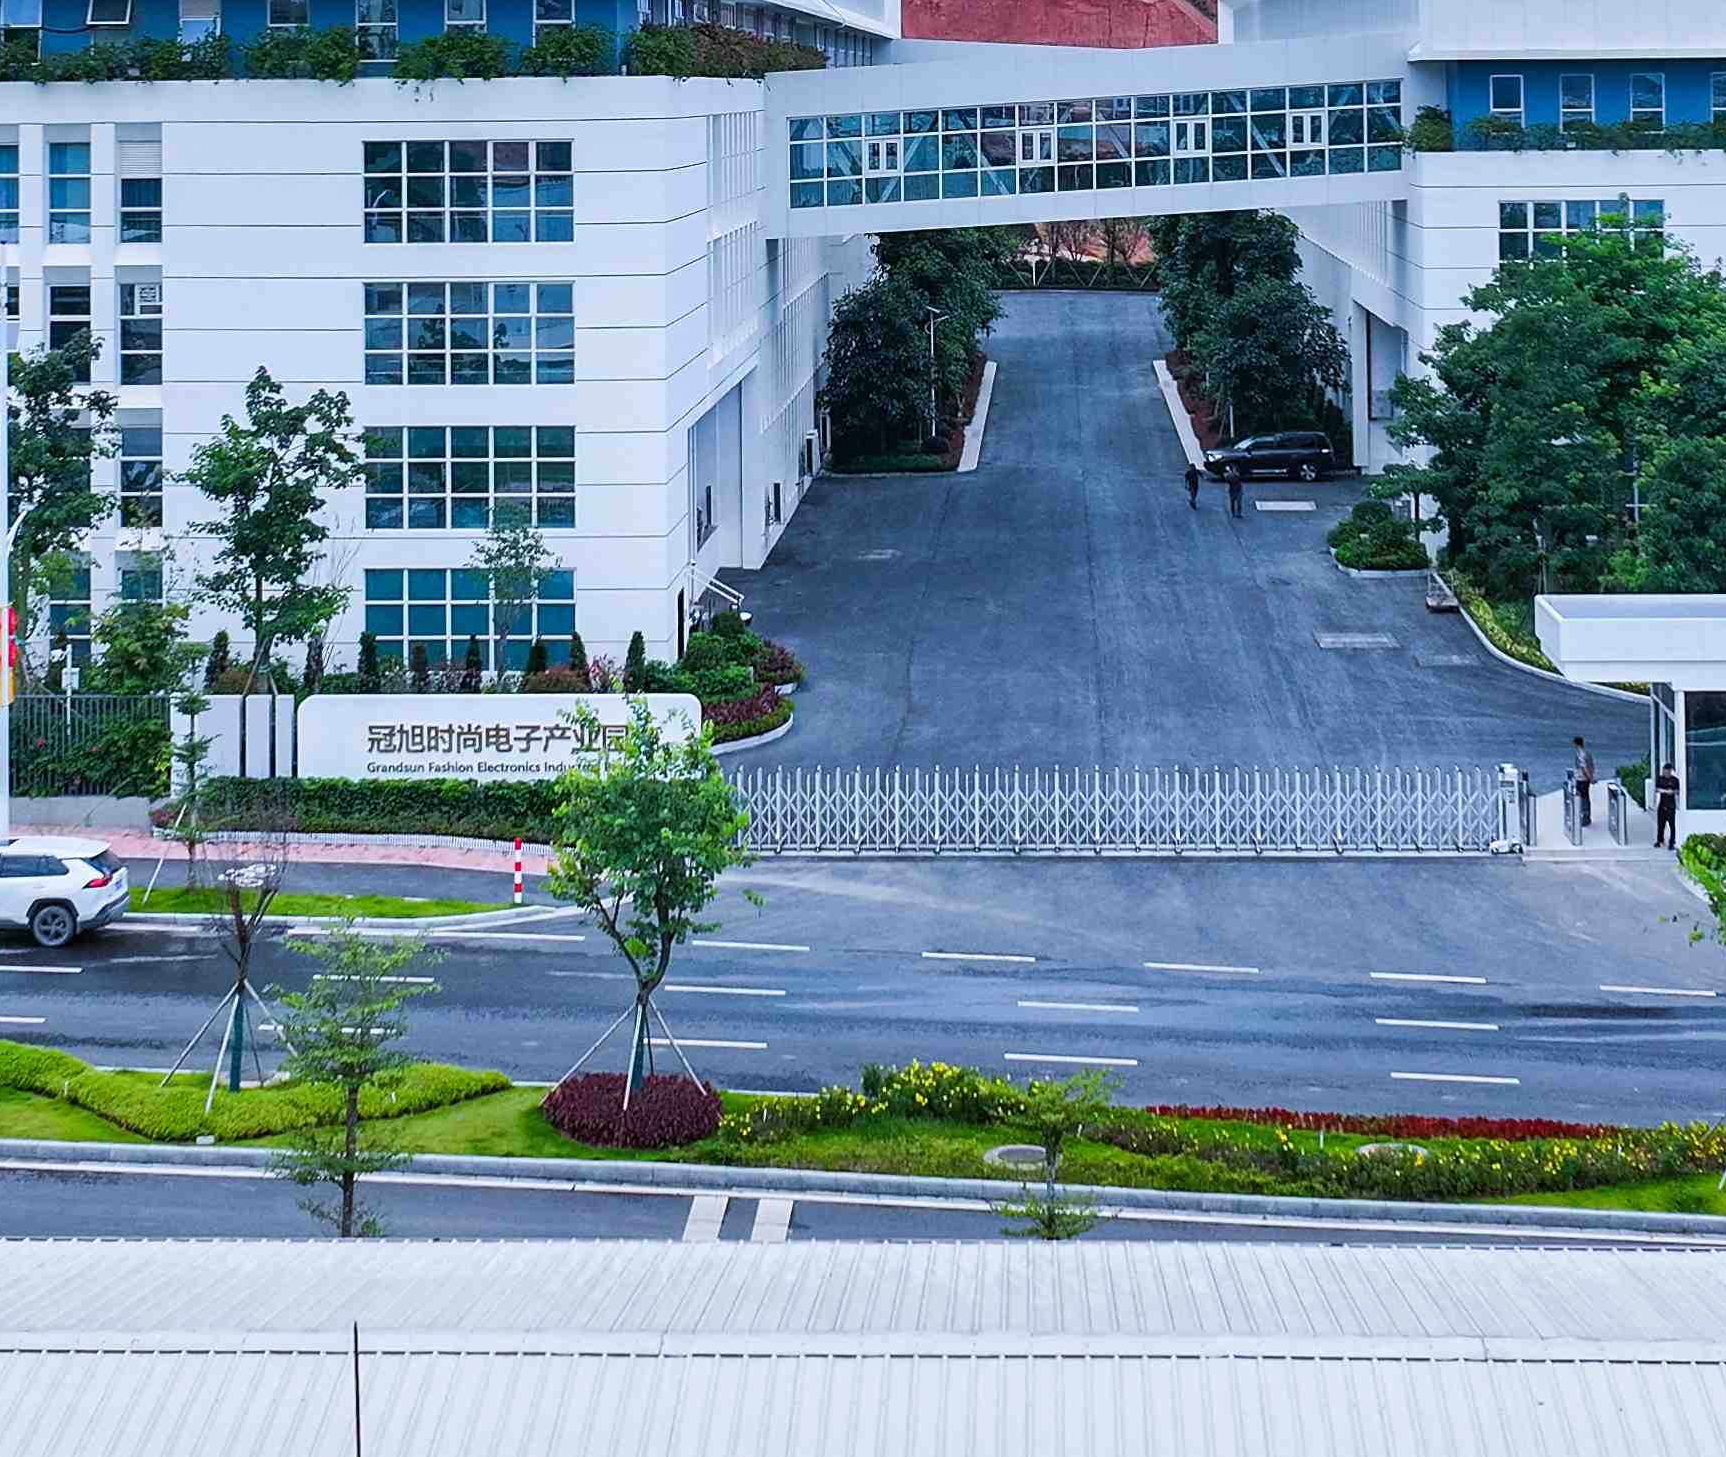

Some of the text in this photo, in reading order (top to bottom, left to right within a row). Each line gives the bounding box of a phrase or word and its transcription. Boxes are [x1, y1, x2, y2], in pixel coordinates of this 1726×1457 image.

[367, 762, 424, 773] Grandsun
[428, 761, 474, 773] Fashion
[477, 760, 541, 773] Electronics
